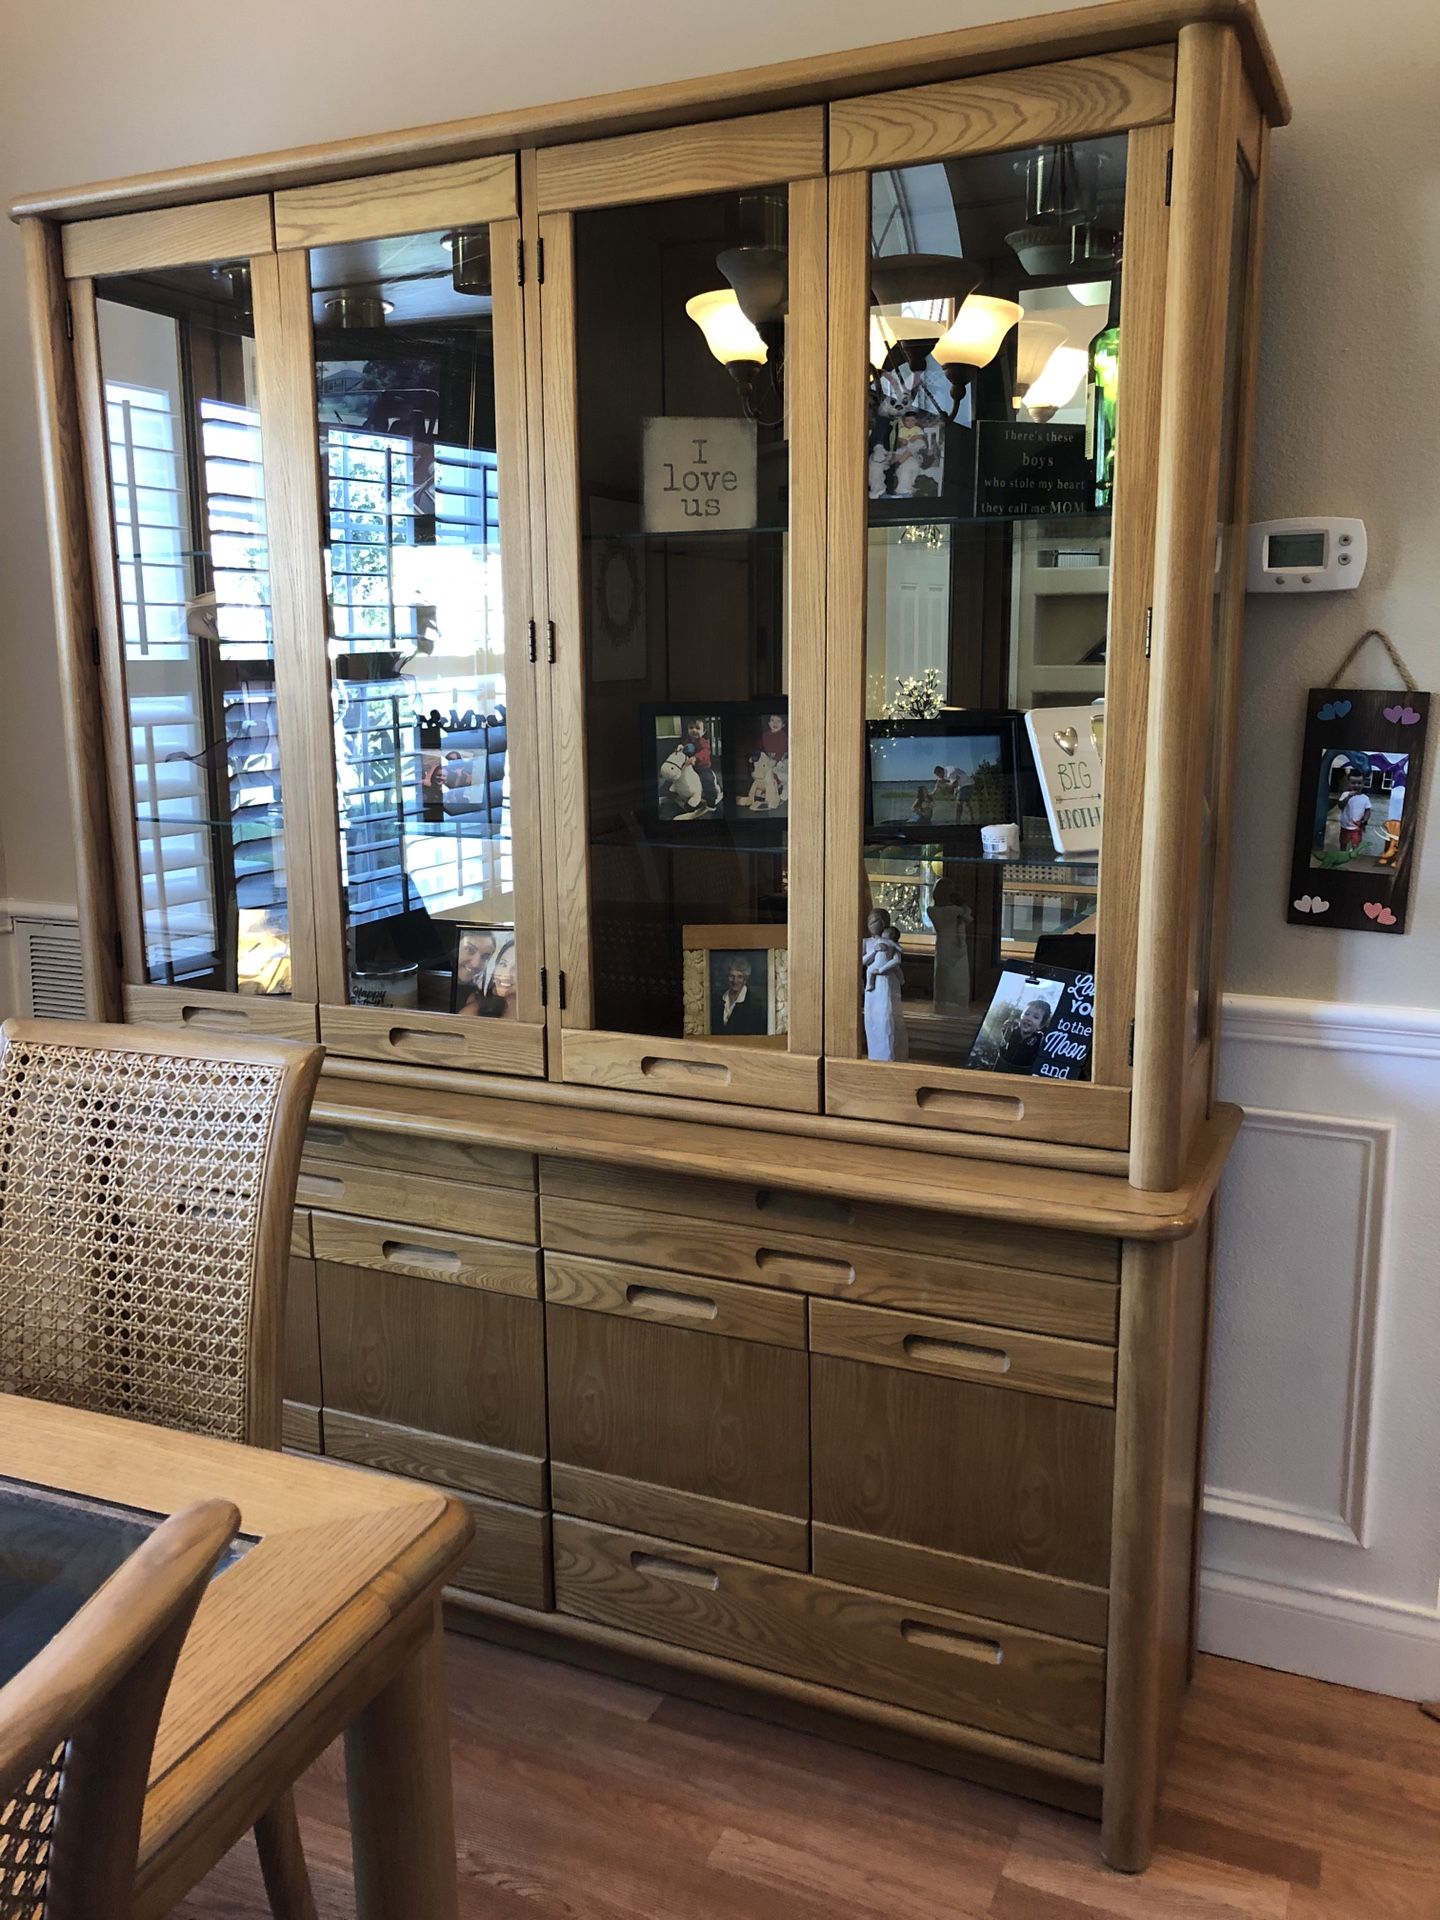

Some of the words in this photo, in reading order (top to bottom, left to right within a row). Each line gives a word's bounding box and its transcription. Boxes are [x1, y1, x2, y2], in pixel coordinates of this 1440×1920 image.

[1004, 430, 1042, 441] There's
[1046, 431, 1074, 443] these
[692, 439, 707, 464] I
[1022, 452, 1054, 469] boys
[663, 463, 738, 491] love
[984, 476, 1006, 488] who
[1010, 477, 1035, 488] stole
[1038, 481, 1053, 491] my
[1057, 478, 1085, 490] heart
[681, 498, 721, 517] us
[981, 502, 1003, 515] they
[1008, 502, 1028, 513] call
[1031, 505, 1046, 513] me
[1057, 761, 1092, 791] BIG
[1056, 807, 1101, 830] BROTH
[352, 985, 388, 1003] Happy
[1067, 974, 1096, 1000] Lo
[1057, 1018, 1069, 1031] to
[1070, 1020, 1093, 1036] the
[1043, 1031, 1087, 1060] Moon
[1040, 1063, 1070, 1080] and
